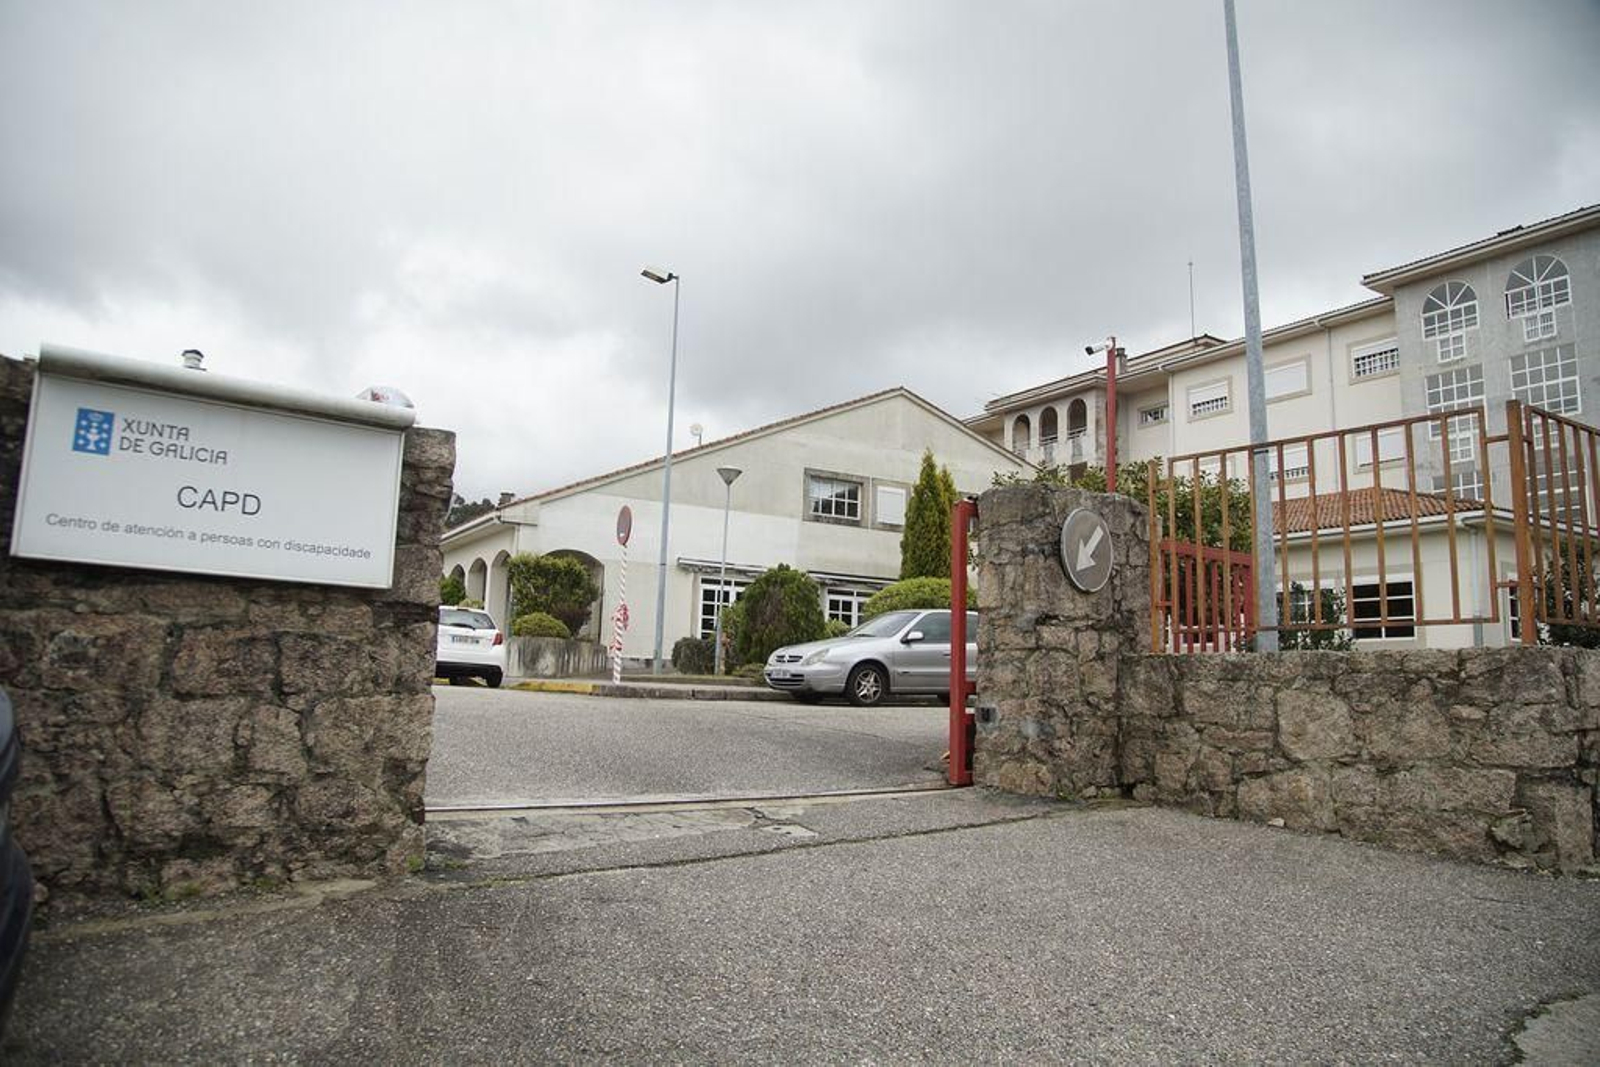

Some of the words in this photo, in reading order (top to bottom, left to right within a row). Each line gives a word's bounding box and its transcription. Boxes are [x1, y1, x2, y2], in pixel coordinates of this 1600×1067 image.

[122, 418, 190, 442] XUNTA
[118, 436, 144, 454] DE
[148, 441, 228, 465] GALICIA
[177, 486, 262, 516] CAPD
[45, 512, 97, 530] Centro
[101, 520, 120, 533] de
[124, 523, 185, 539] atención
[187, 530, 197, 541] a
[200, 532, 254, 547] persoas
[257, 539, 281, 550] con
[284, 541, 371, 559] discapacidade
